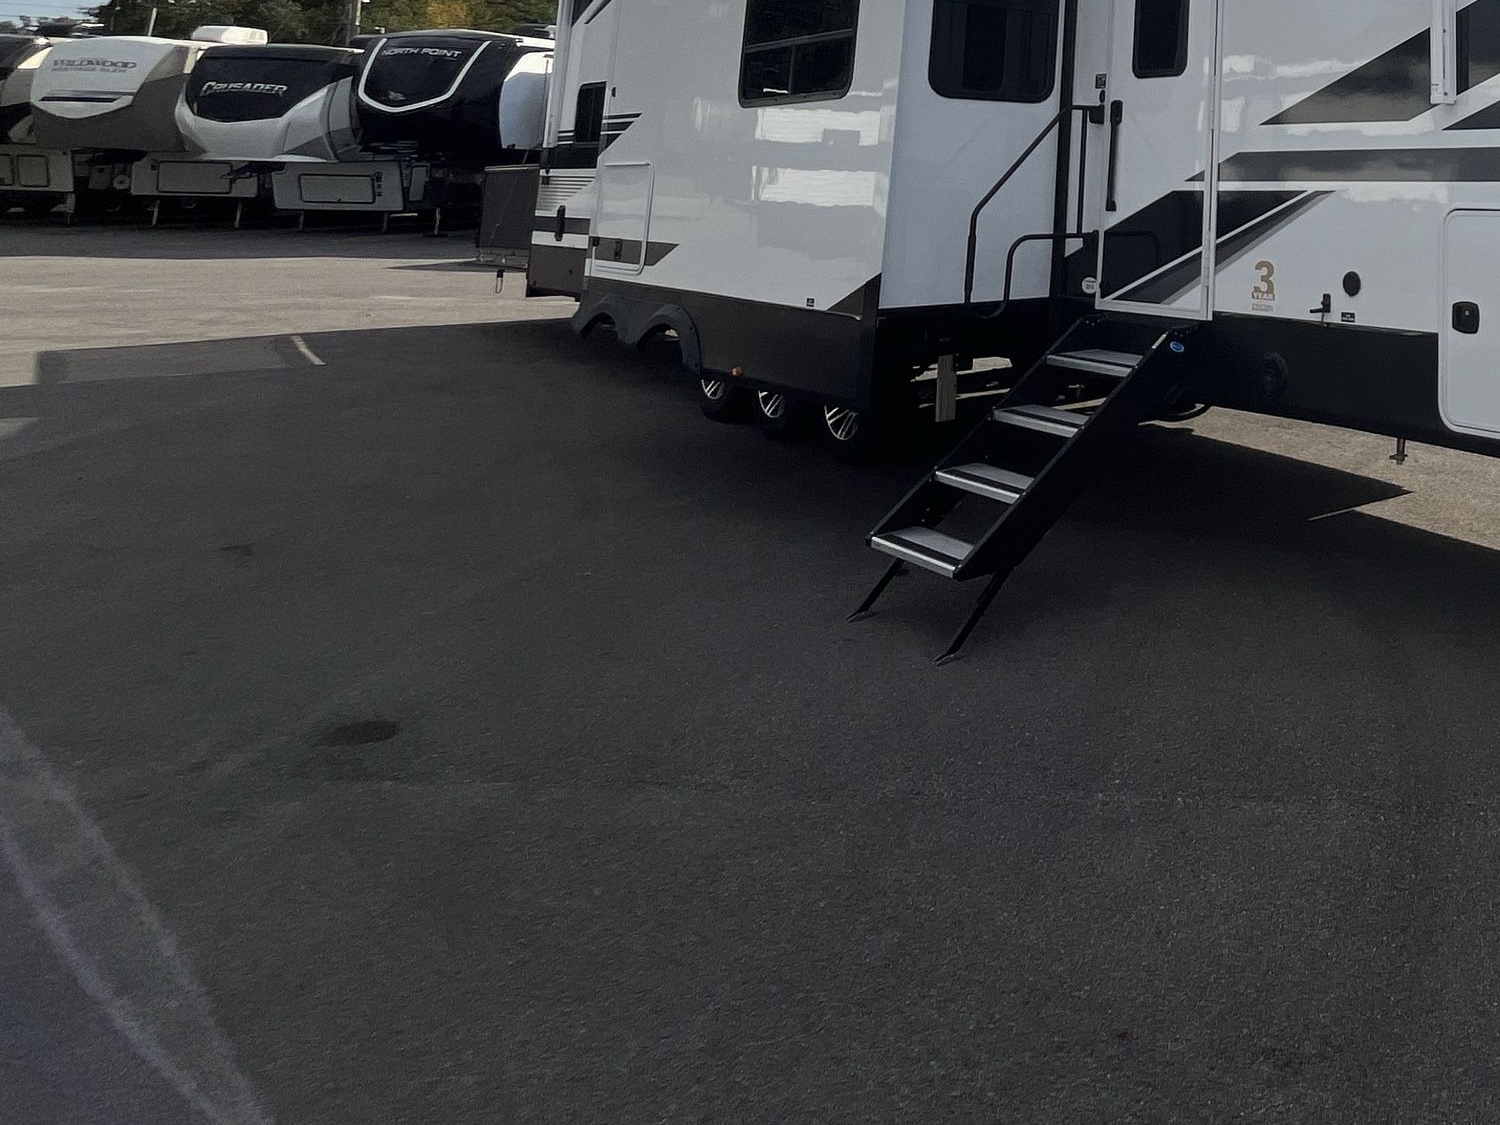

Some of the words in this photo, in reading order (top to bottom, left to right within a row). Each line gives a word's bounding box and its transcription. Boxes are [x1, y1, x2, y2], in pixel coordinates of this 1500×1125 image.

[421, 48, 462, 57] POINT
[200, 81, 288, 96] CRUSADER
[1254, 260, 1275, 294] 3
[1253, 291, 1274, 300] YEAR
